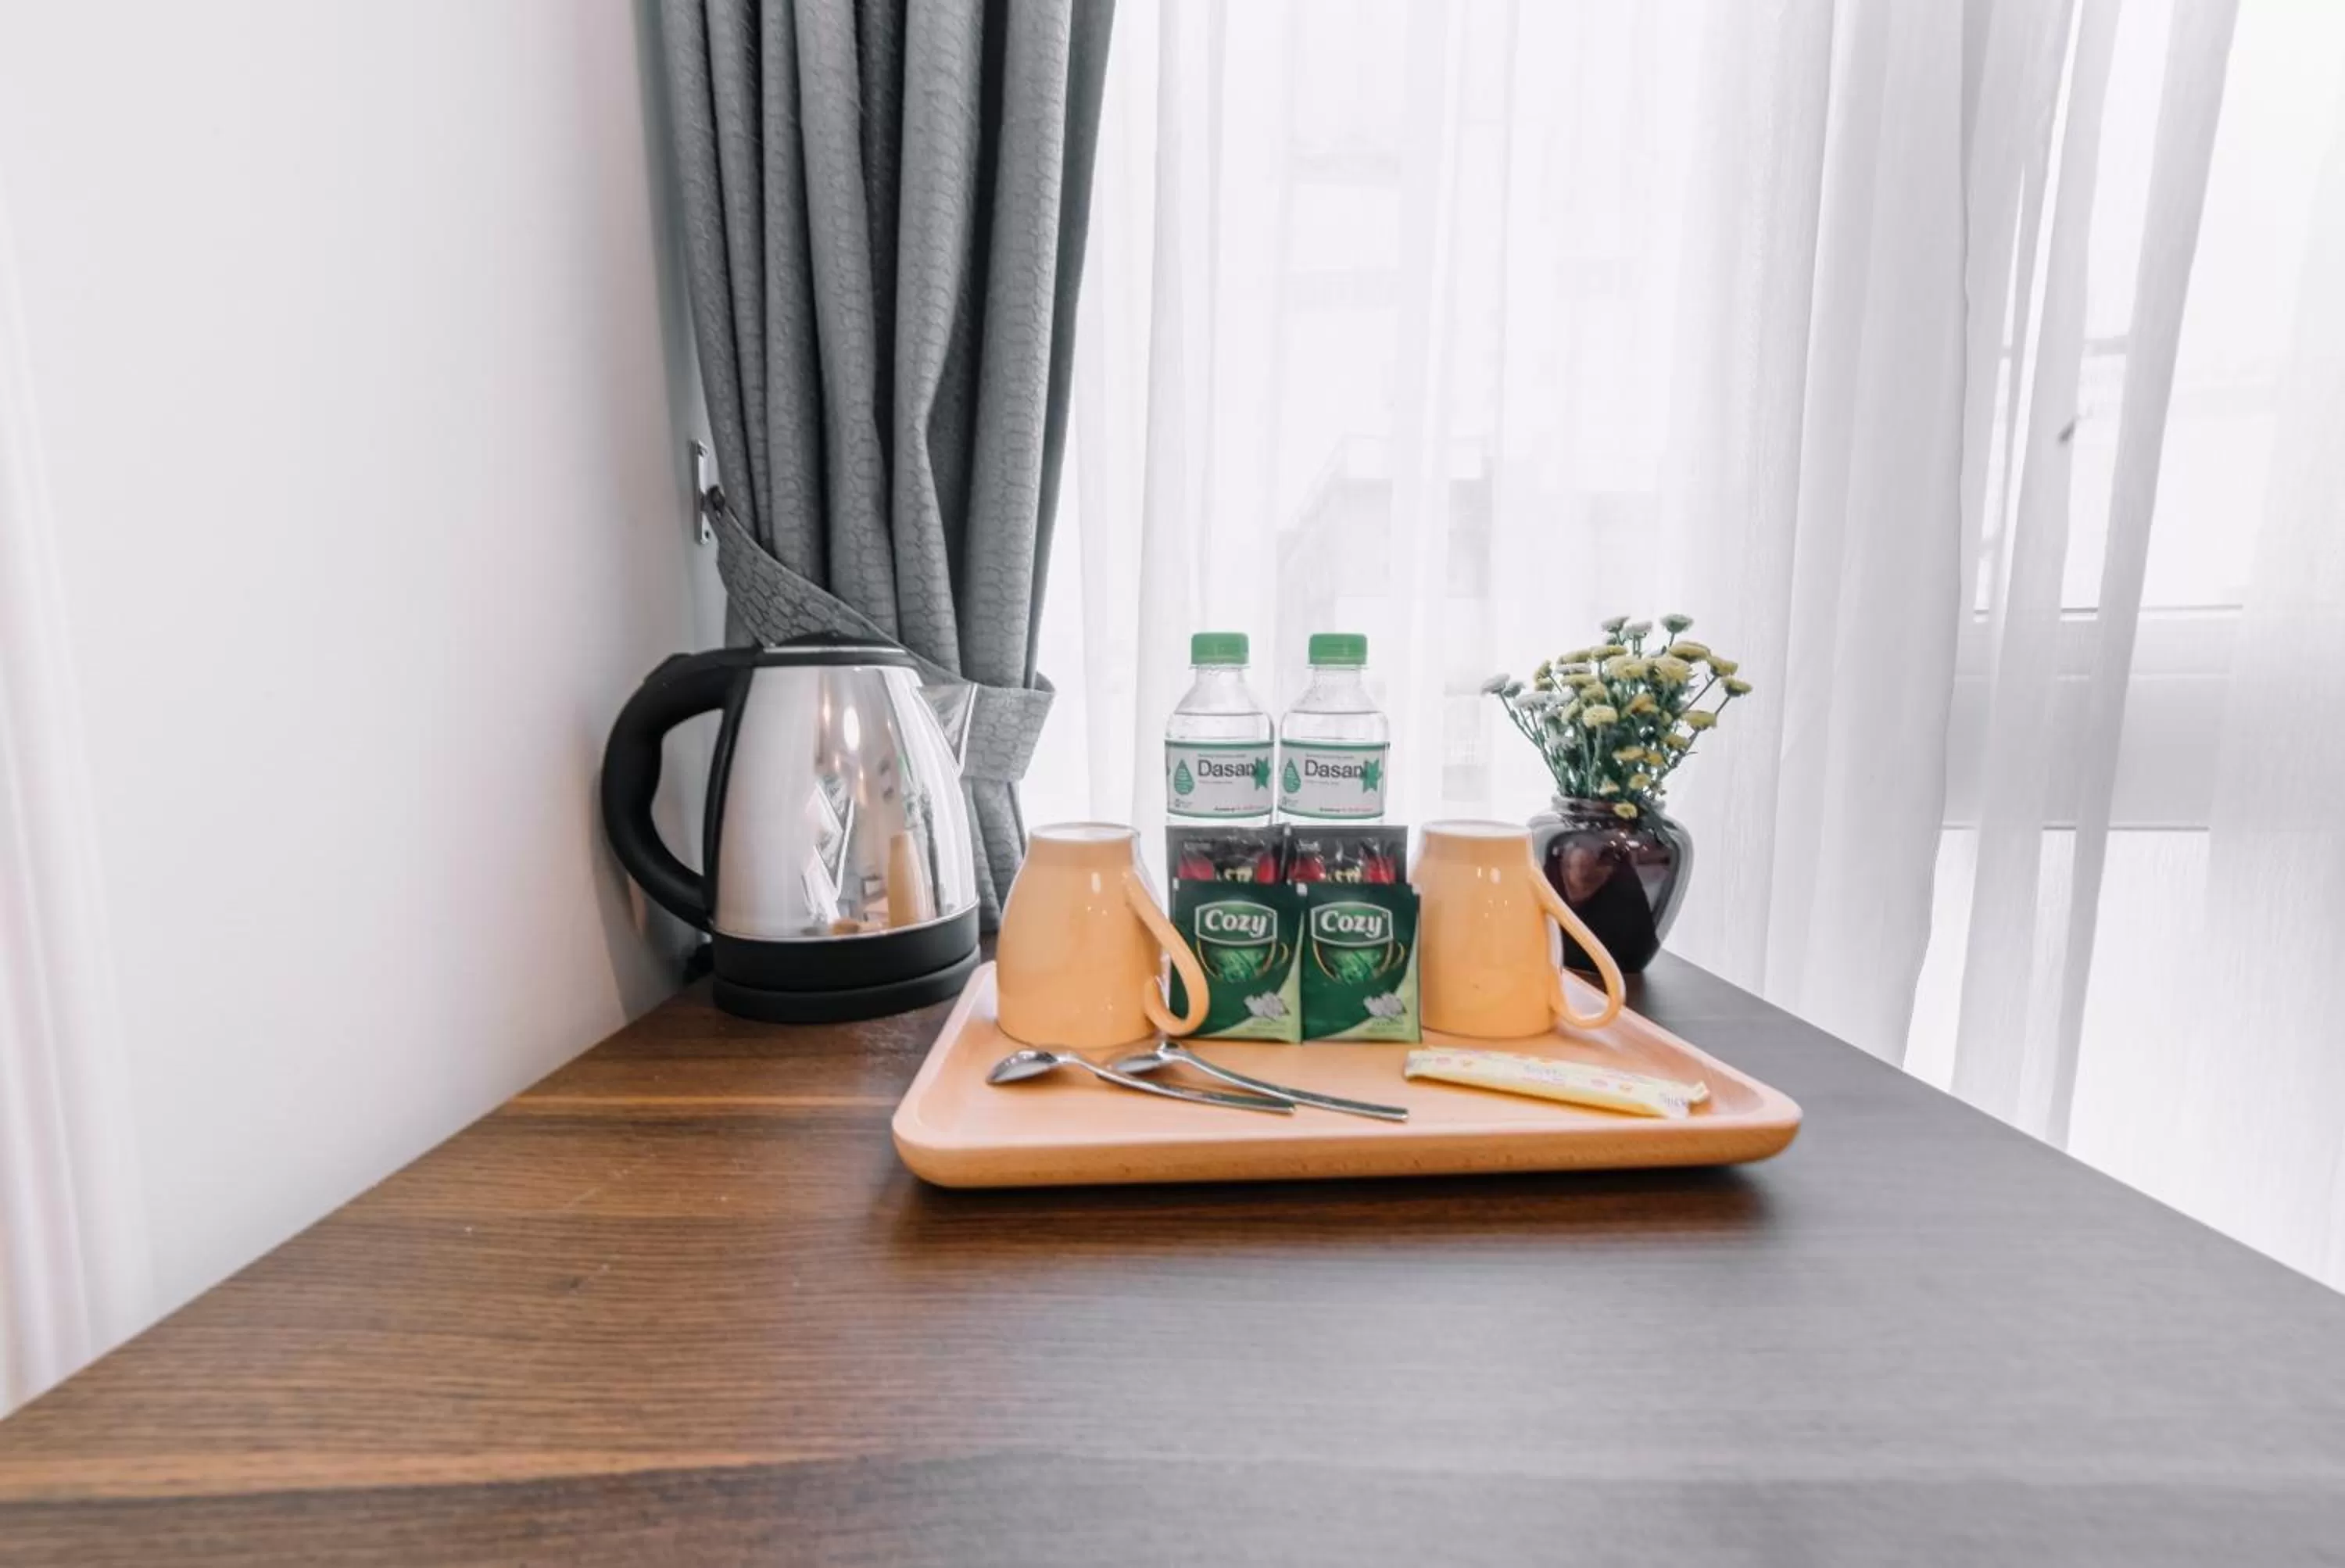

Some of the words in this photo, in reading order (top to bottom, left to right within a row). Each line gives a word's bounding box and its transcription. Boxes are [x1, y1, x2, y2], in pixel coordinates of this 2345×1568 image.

[1198, 758, 1260, 777] Dasan
[1305, 759, 1369, 779] Dasan
[1205, 909, 1267, 938] Cozy
[1320, 910, 1382, 938] Cozy
